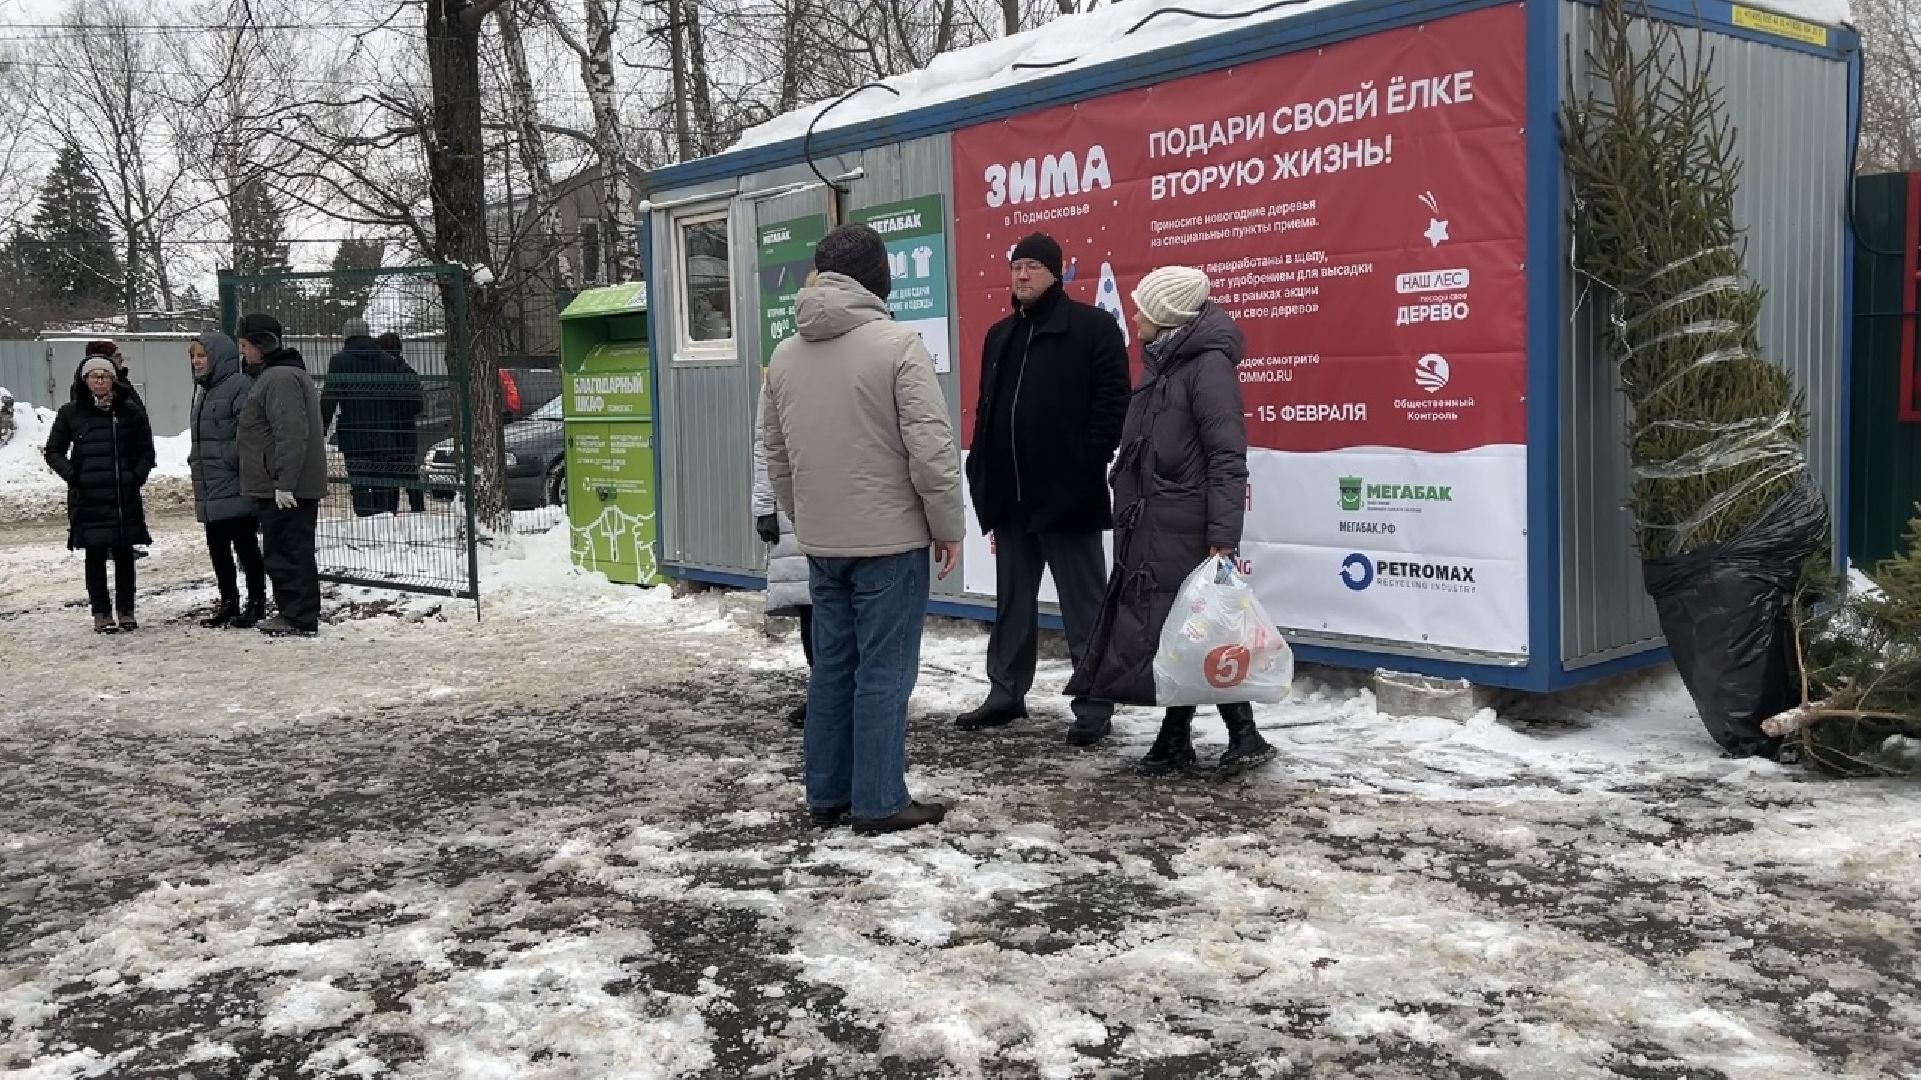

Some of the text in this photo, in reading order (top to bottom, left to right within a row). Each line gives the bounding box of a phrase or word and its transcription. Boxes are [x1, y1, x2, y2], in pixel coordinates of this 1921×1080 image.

[1149, 70, 1474, 158] ПОДАРИ СВОЕЙ ЁЛКЕ
[984, 145, 1112, 208] ЗИМА
[1151, 134, 1392, 200] ВТОРУЮ ЖИЗНЬ!
[1004, 203, 1090, 226] в Подмосковье
[1151, 199, 1316, 232] Приносите новогодние деревья
[1151, 237, 1162, 248] на
[1163, 228, 1231, 246] специальные
[1232, 223, 1271, 240] пункты
[1207, 252, 1283, 274] переработаны
[1286, 254, 1292, 264] в
[1228, 271, 1295, 290] удобрением
[1297, 267, 1319, 282] для
[1321, 262, 1373, 279] высадки
[1402, 272, 1462, 289] НАШ ЛЕС
[1234, 293, 1240, 303] в
[1242, 288, 1281, 304] рамках
[1284, 284, 1319, 300] акции
[1243, 306, 1268, 318] свое
[1397, 302, 1469, 326] ДЕРЕВО
[1267, 354, 1320, 367] смотрите
[573, 372, 644, 394] БЛАГОДАРНЫЙ
[1239, 369, 1292, 383] OMMO.RU
[575, 395, 604, 412] ШКАФ
[1258, 405, 1277, 422] 15
[1281, 403, 1368, 421] ФЕВРАЛЯ
[1394, 396, 1476, 409] Общественный
[1407, 411, 1458, 422] Контроль
[1367, 484, 1452, 501] МЕГАБАК
[1339, 521, 1396, 535] МЕГАБАК.РФ
[1377, 562, 1475, 582] PETROMAX
[1377, 578, 1476, 593] RECYCLING INDUSTRY
[1216, 645, 1245, 683] 5
